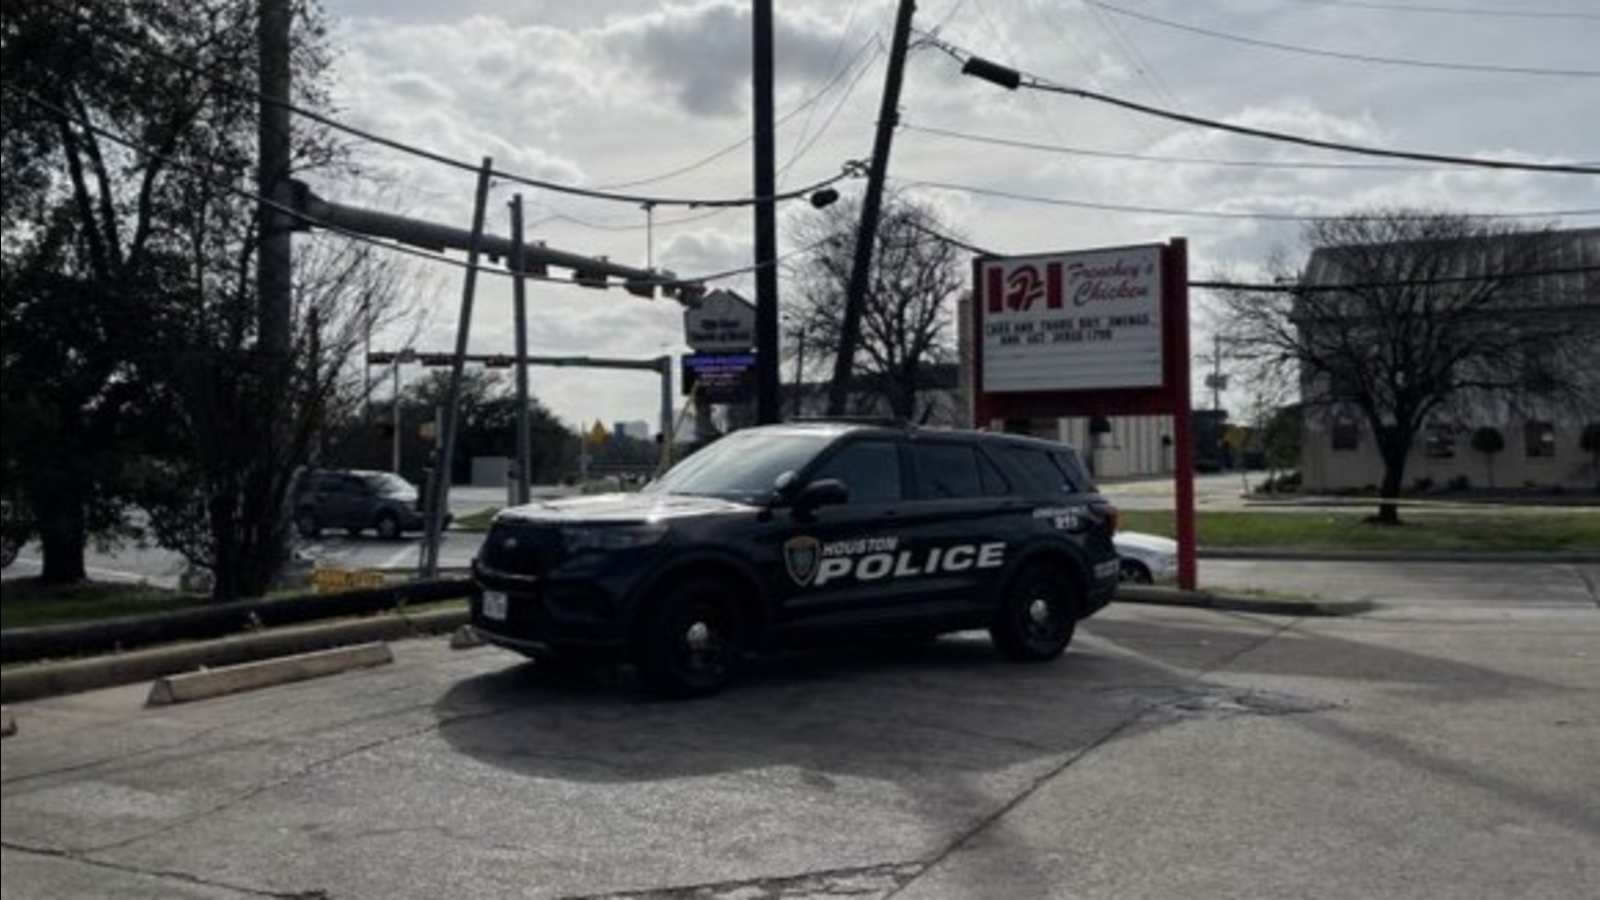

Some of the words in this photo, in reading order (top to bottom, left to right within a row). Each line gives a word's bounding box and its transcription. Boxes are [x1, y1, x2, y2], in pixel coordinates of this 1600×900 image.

[1074, 280, 1148, 307] Chicken
[823, 536, 899, 556] HOUSTON
[813, 541, 1006, 586] POLICE
